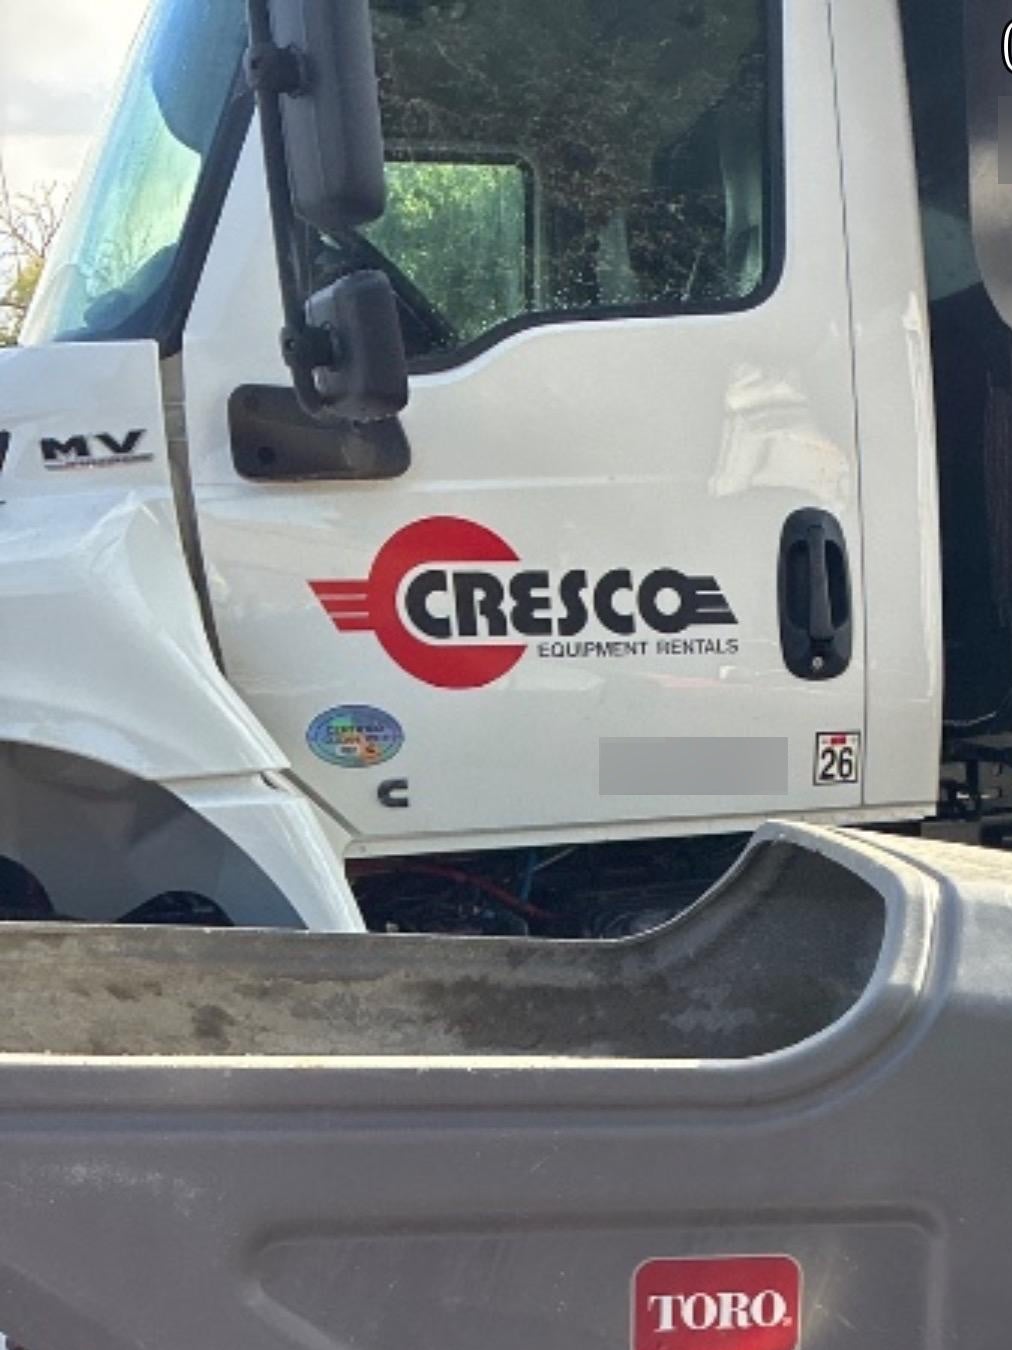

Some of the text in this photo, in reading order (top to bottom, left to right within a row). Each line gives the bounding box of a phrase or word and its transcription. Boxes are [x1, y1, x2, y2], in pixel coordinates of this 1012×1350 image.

[40, 428, 148, 460] MV
[404, 567, 696, 639] CRESCO
[537, 639, 740, 659] EQUIPMENT RENTALS
[820, 746, 853, 780] 26
[648, 1290, 788, 1334] TORO
